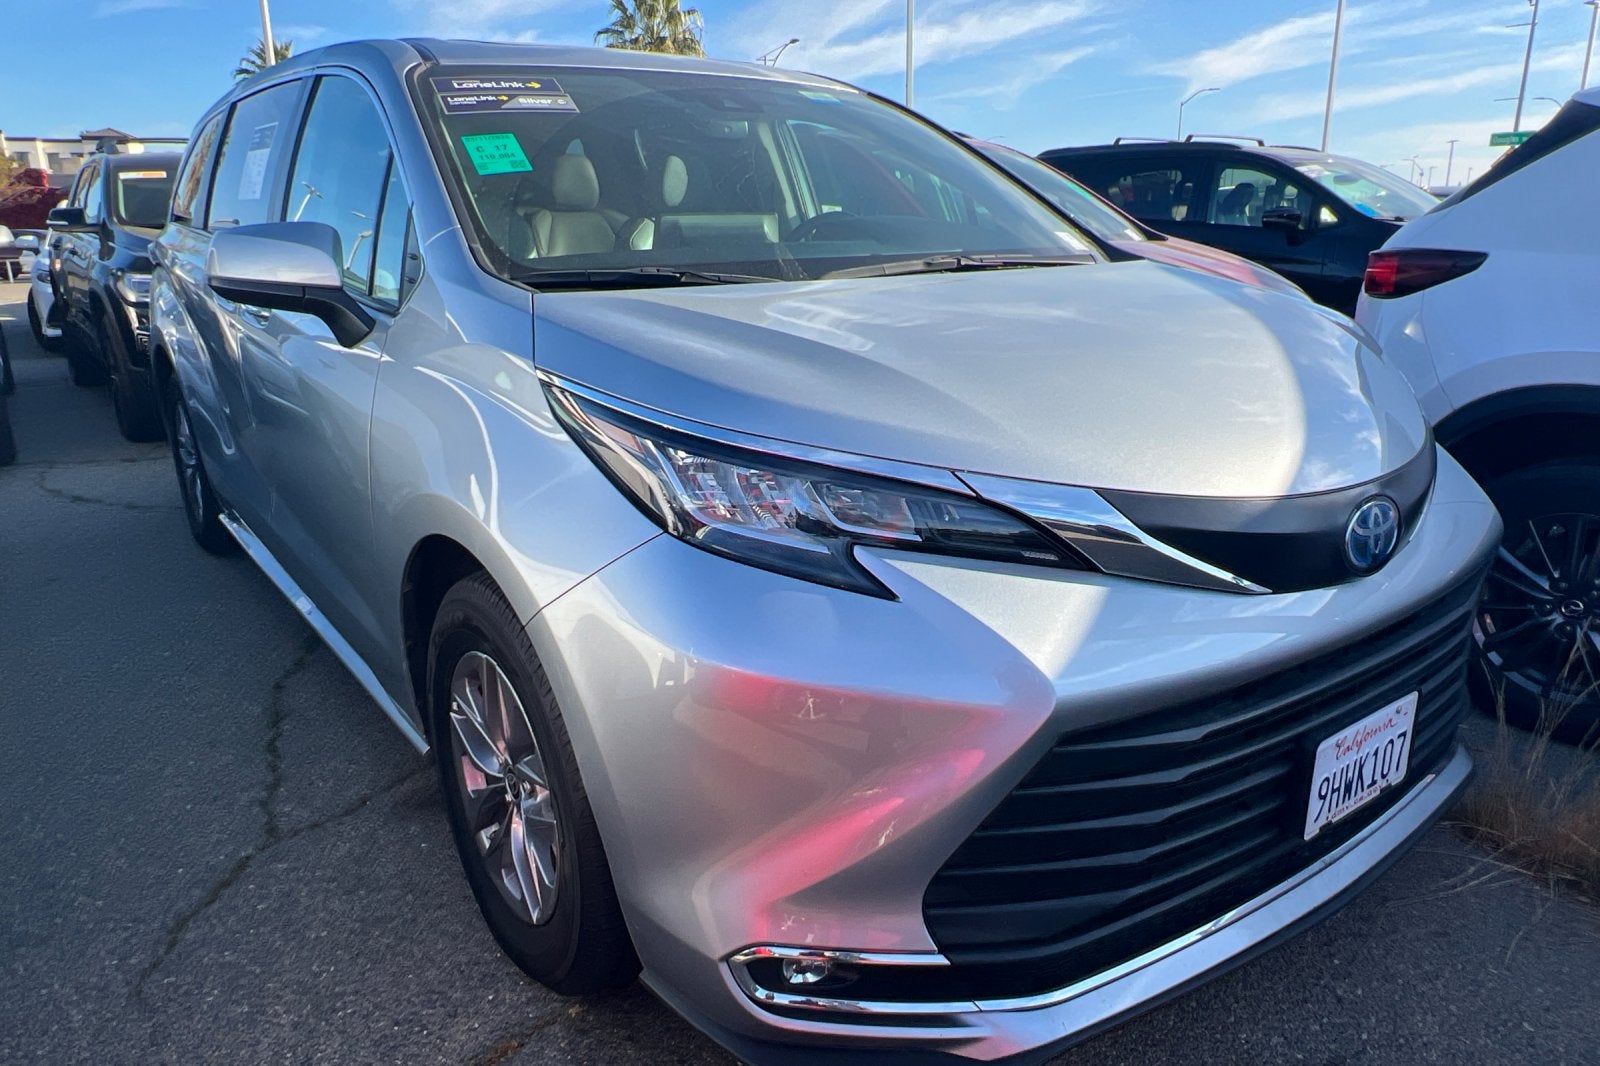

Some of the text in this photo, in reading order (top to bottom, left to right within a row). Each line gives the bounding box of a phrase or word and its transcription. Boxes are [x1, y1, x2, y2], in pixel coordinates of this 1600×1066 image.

[453, 81, 525, 89] LaneLink
[518, 97, 553, 105] Silver
[476, 143, 509, 153] C 17
[1335, 717, 1398, 761] California
[1314, 729, 1408, 824] 9HWK107
